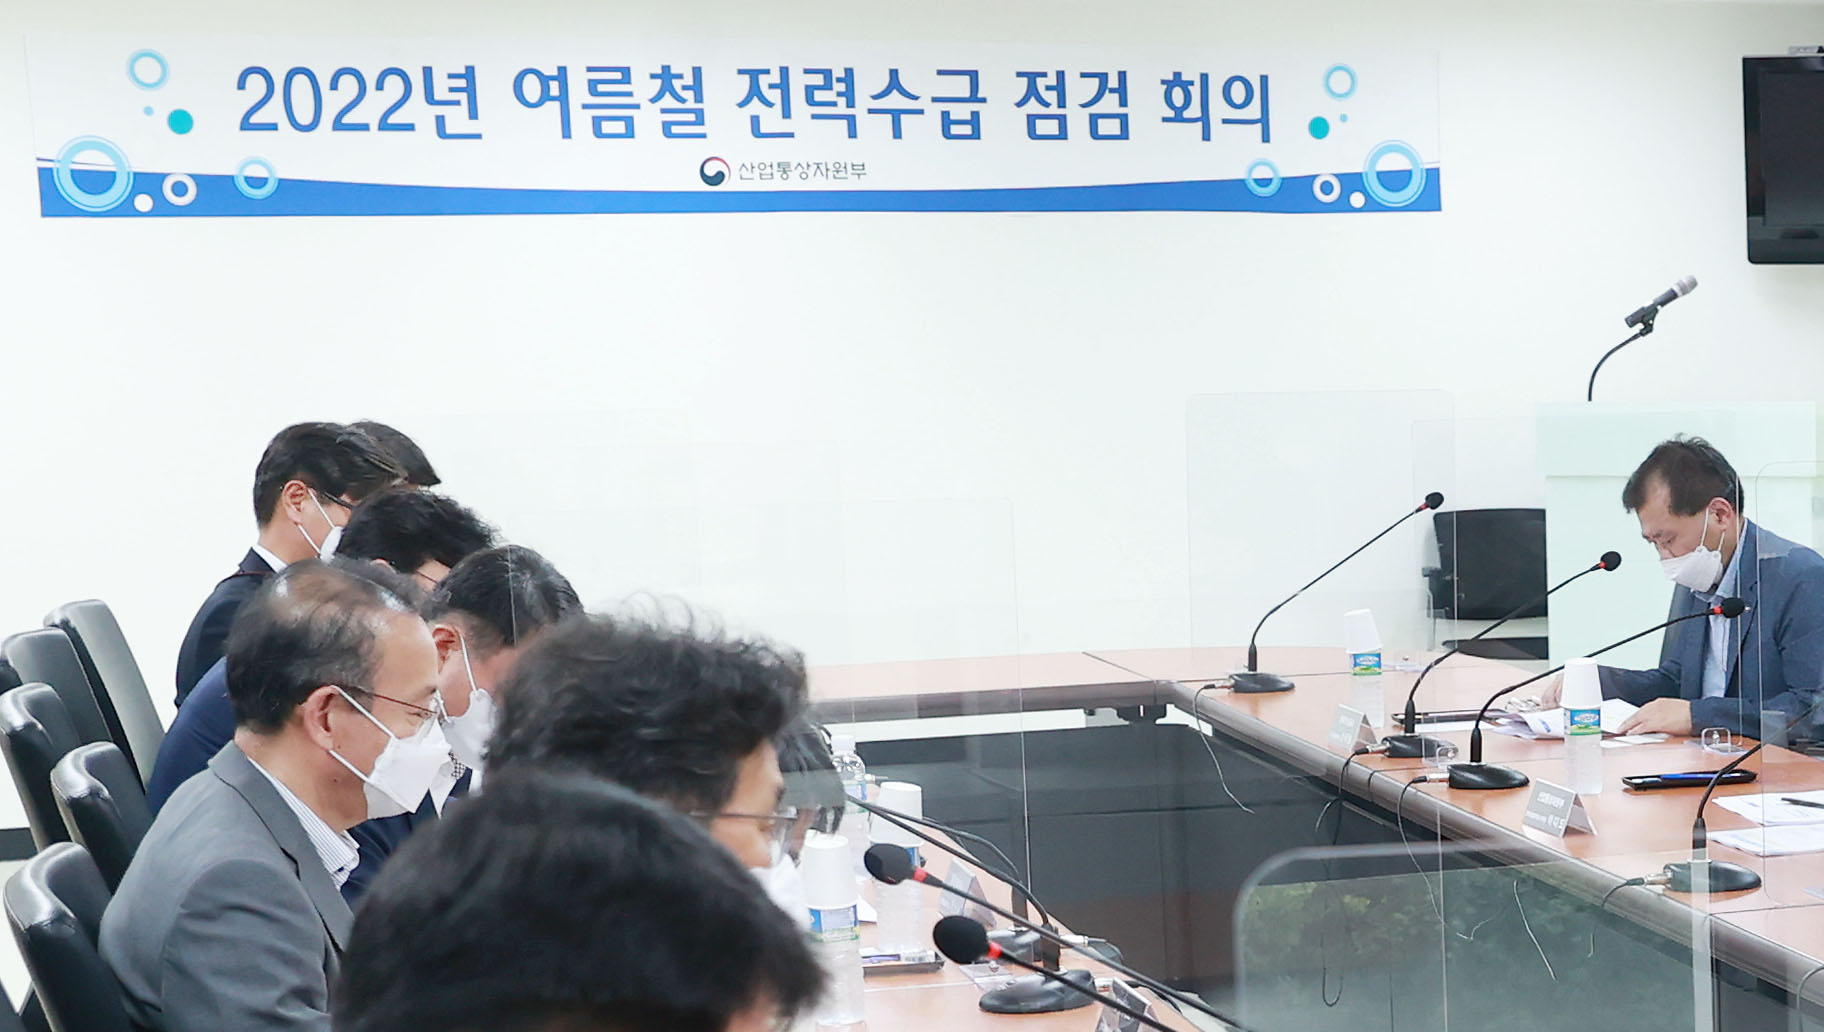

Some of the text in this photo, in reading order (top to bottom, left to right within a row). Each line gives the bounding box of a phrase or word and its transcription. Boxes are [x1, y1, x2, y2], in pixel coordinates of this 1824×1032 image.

[236, 64, 1271, 144] 2022년 여름철 전력수급 점검 회의
[738, 161, 867, 181] 산업통상자원부
